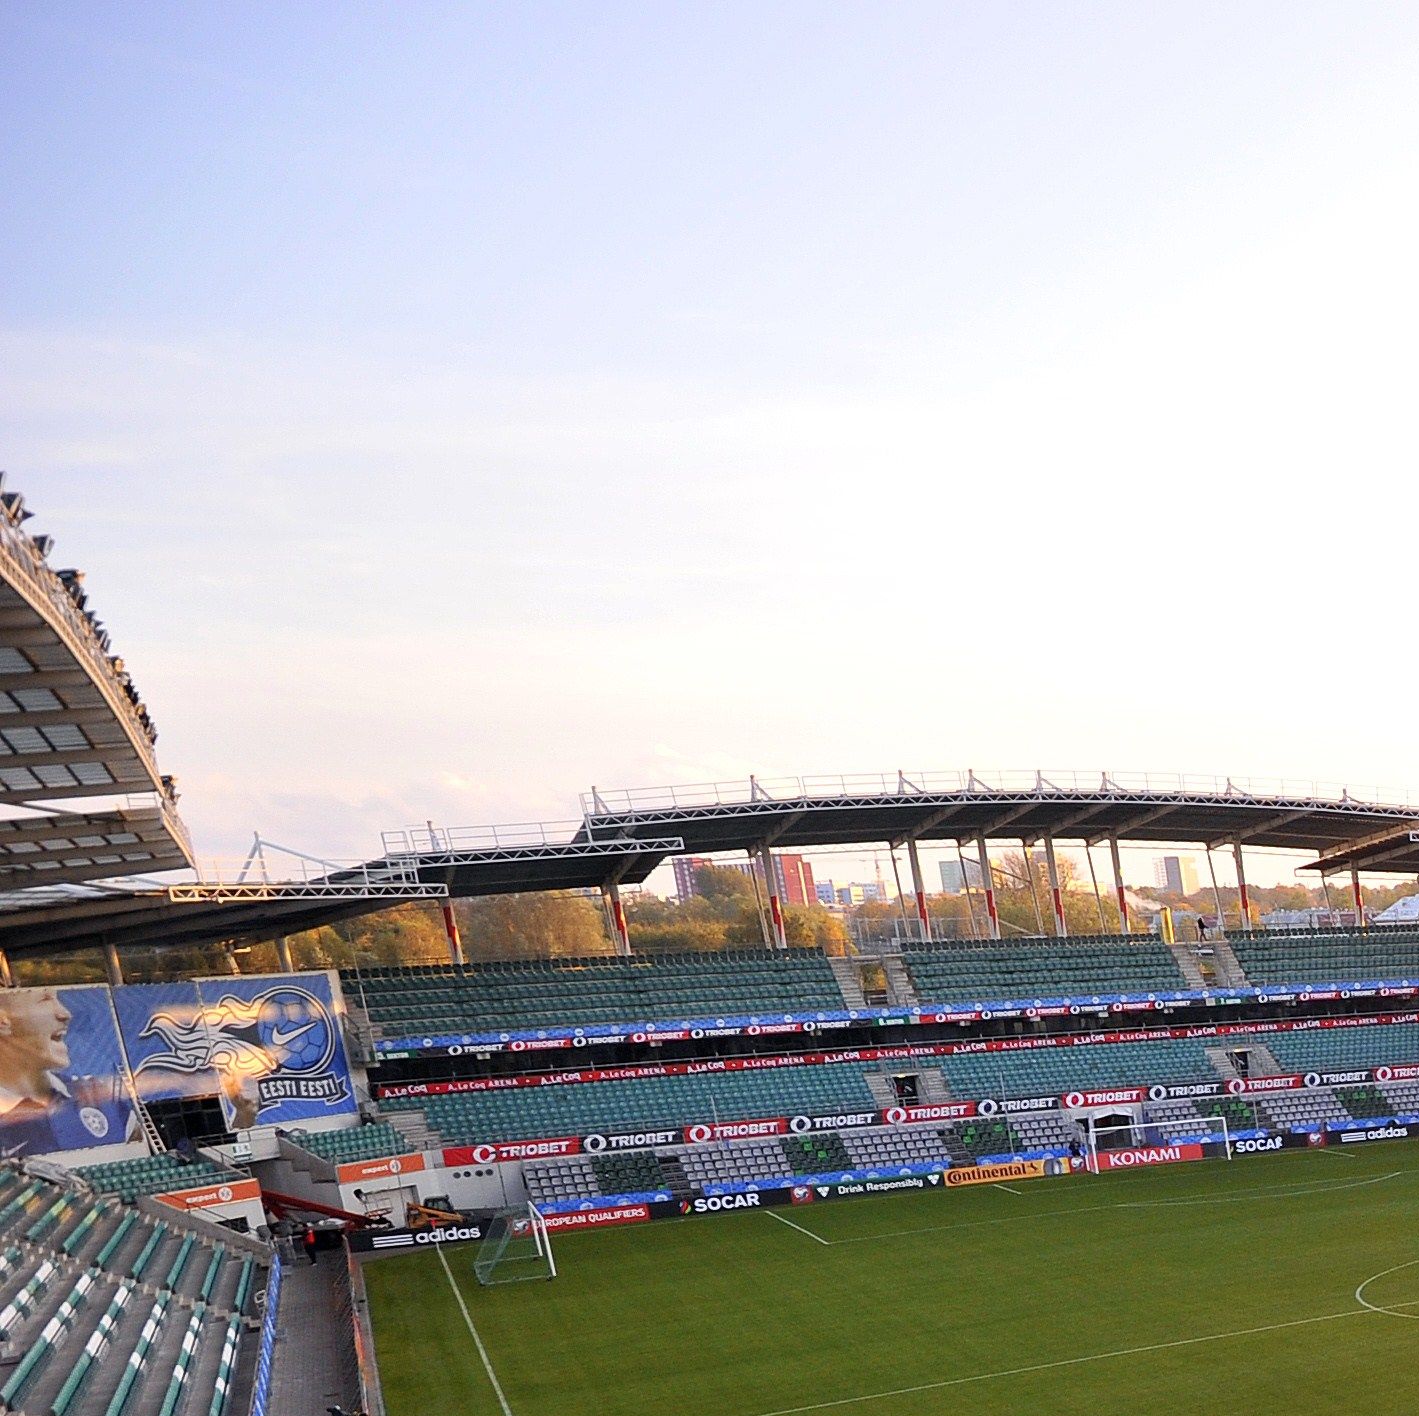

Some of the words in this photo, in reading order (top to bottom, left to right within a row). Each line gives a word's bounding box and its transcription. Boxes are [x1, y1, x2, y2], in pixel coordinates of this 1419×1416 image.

[1244, 1077, 1296, 1090] TRIOBET
[1321, 1071, 1369, 1084] TRIOBET
[260, 1081, 297, 1098] EESTI
[300, 1079, 336, 1096] EESTI
[408, 1084, 427, 1094] Coq
[1167, 1083, 1220, 1097] TRIOBET
[1000, 1097, 1057, 1112] TRIOBET
[1085, 1090, 1141, 1104] TRIOBET
[814, 1113, 875, 1128] TRIOBET
[909, 1104, 968, 1121] TRIOBET
[714, 1121, 779, 1137] TRIOBET
[1367, 1126, 1408, 1140] adidas
[609, 1130, 677, 1147] TRIOBET
[498, 1141, 571, 1159] TRIOBET
[1109, 1147, 1181, 1167] KONAMI
[947, 1163, 1027, 1184] Continental
[837, 1182, 864, 1195] Drink
[866, 1177, 924, 1193] Responsibly
[694, 1193, 761, 1212] SOCAR
[589, 1207, 646, 1223] QUALIFIERS
[416, 1226, 481, 1244] adidas
